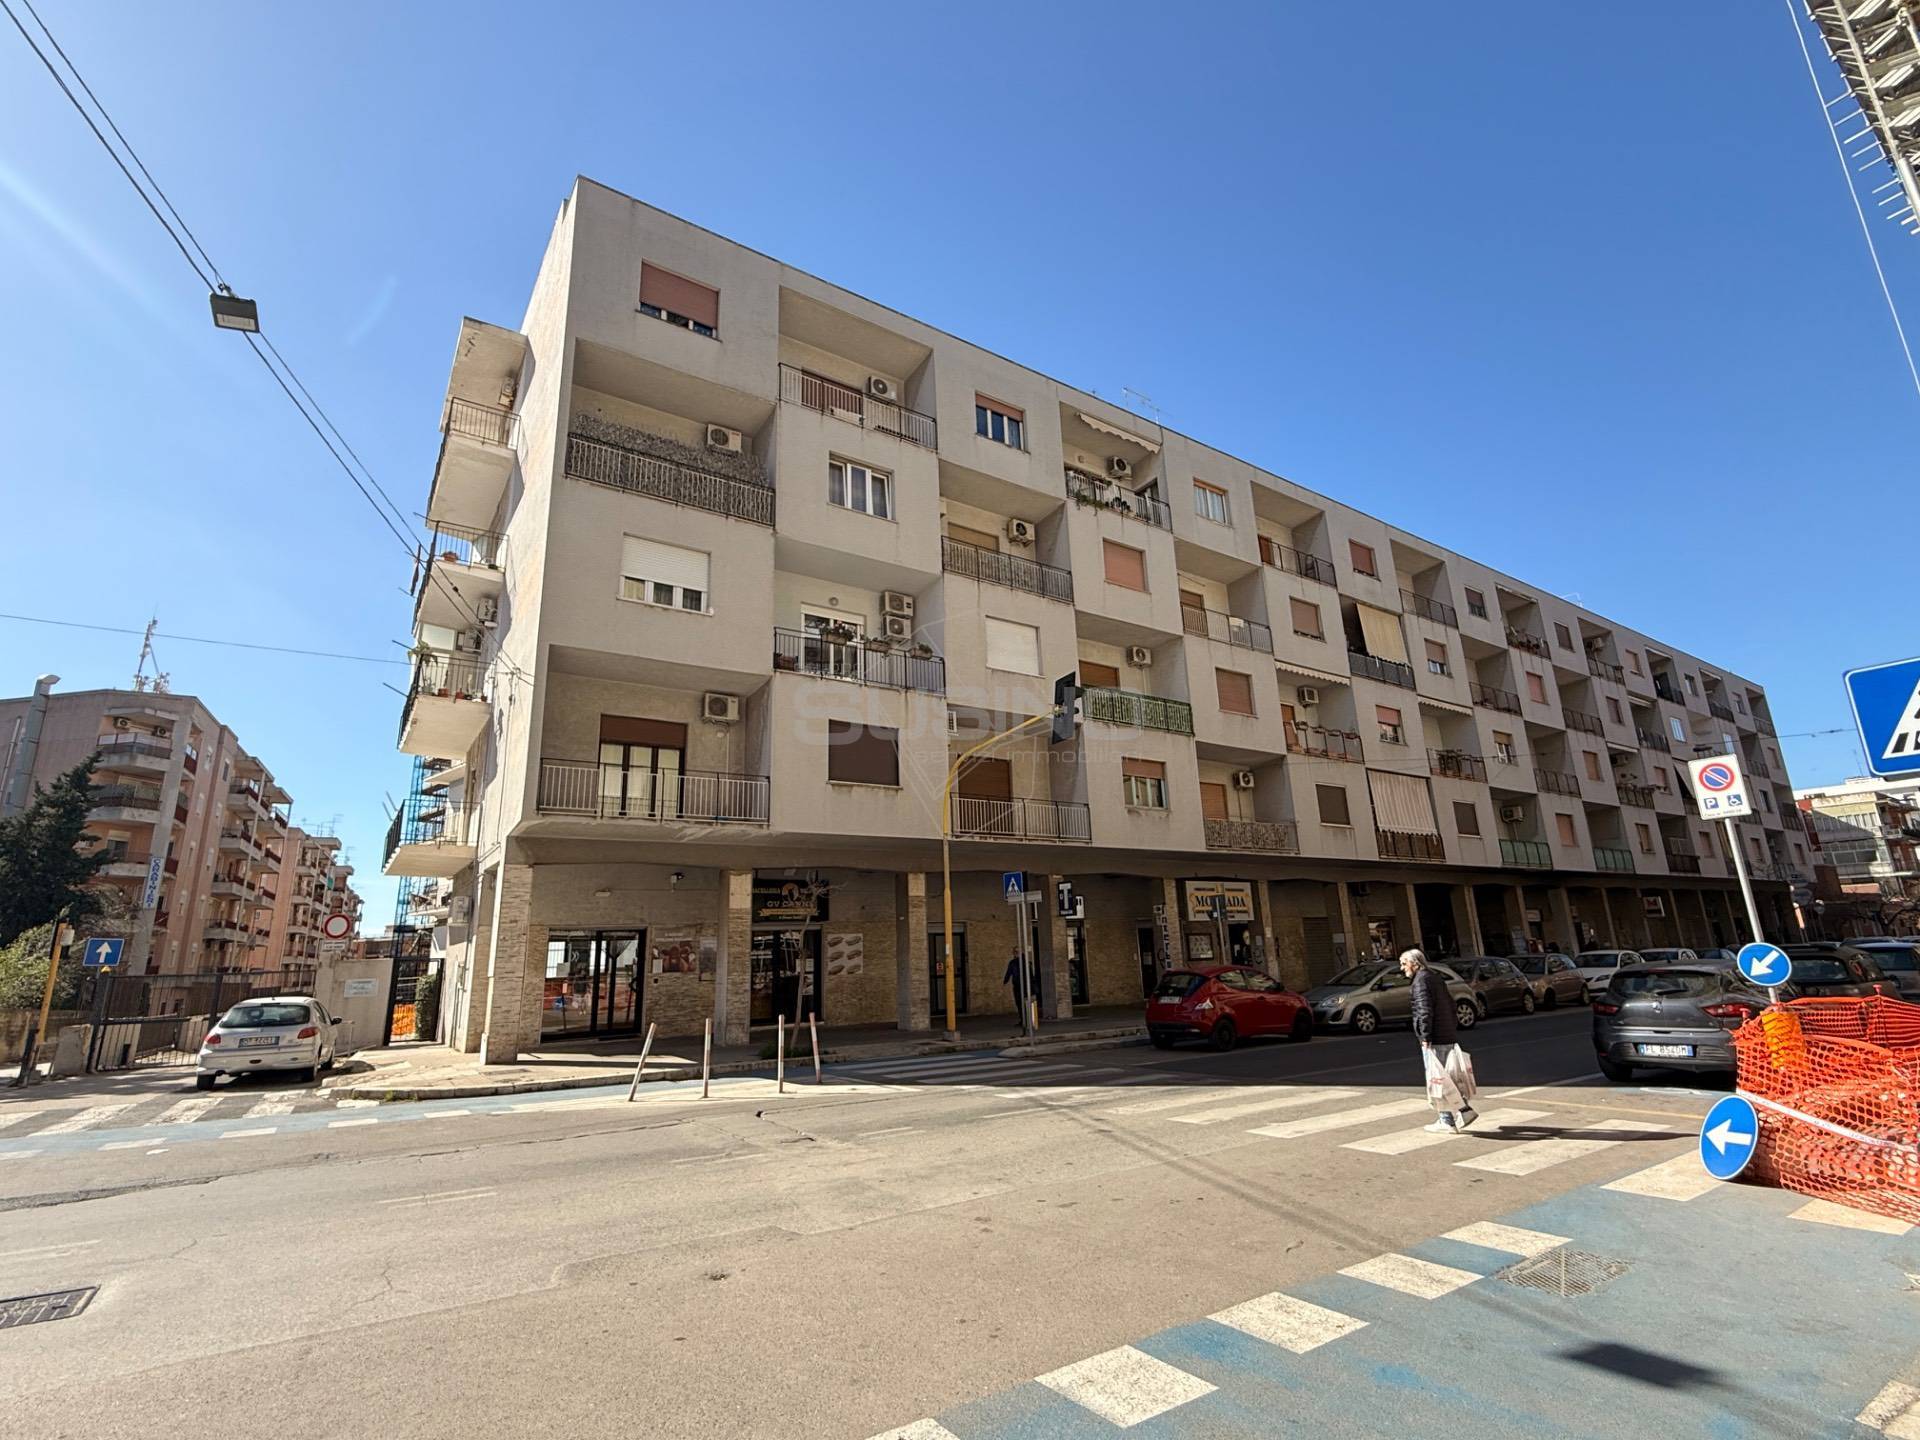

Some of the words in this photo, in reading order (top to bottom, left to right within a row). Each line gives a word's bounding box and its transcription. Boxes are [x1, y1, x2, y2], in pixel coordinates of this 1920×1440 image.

[1706, 798, 1715, 808] P
[146, 859, 161, 908] CARABINIERI
[1195, 895, 1247, 907] MOADA
